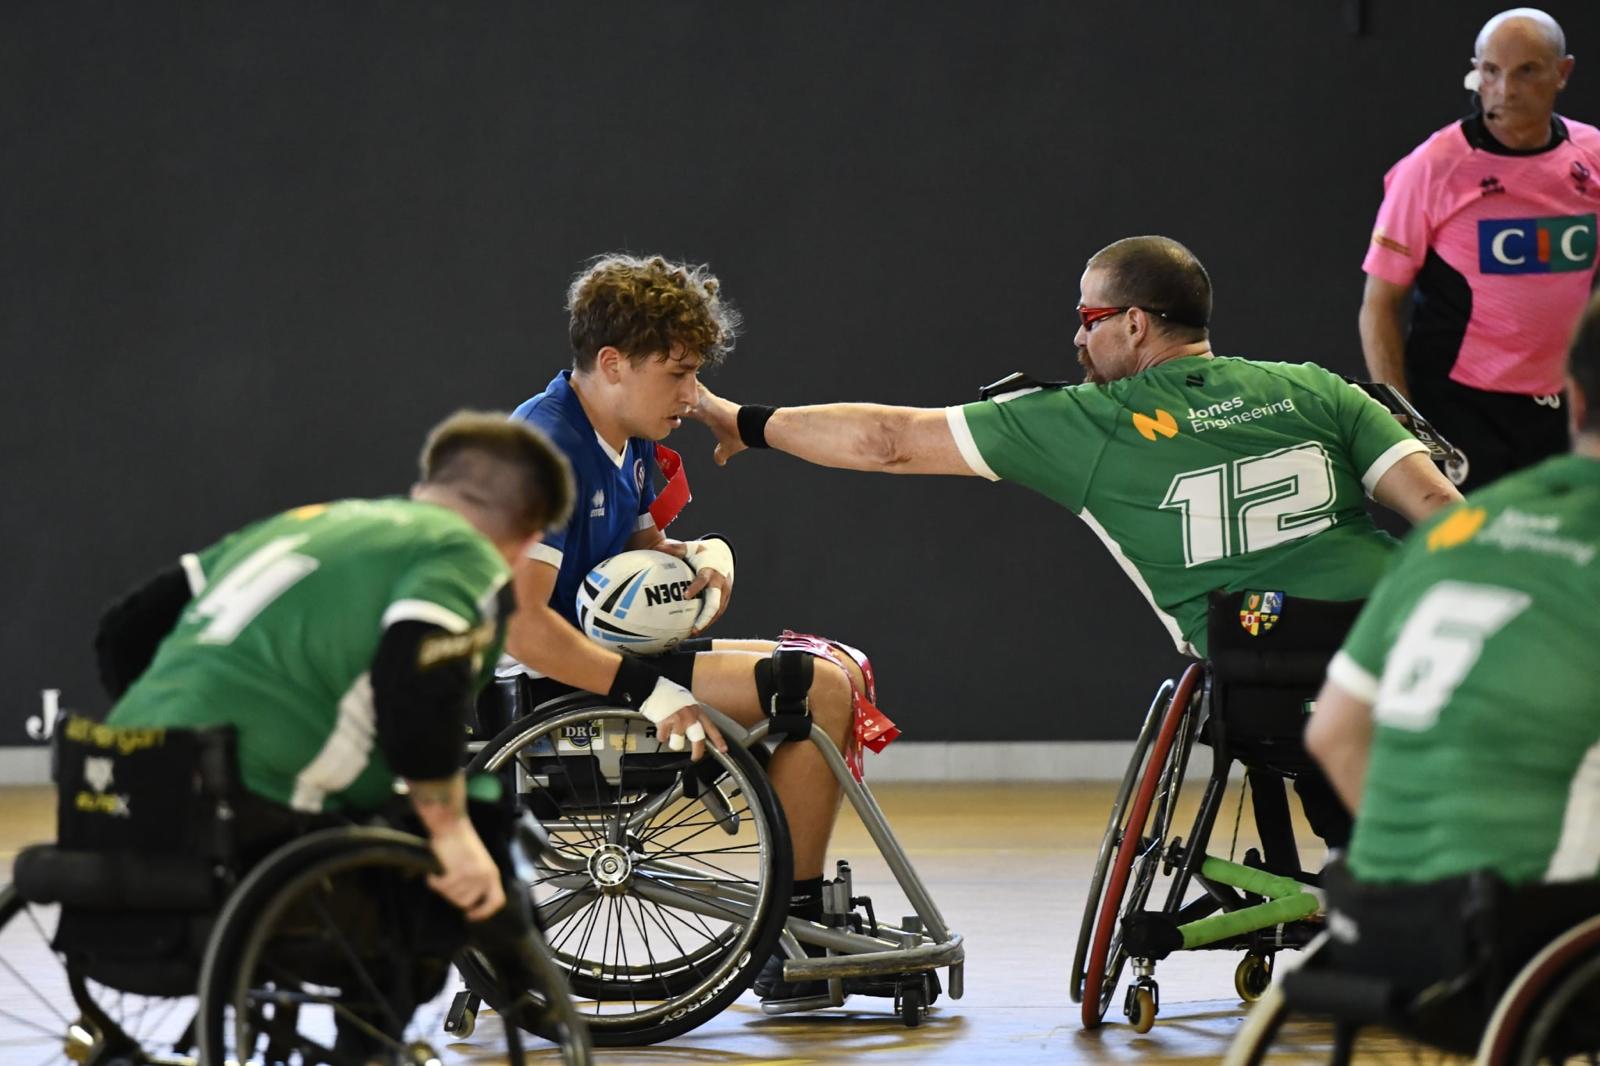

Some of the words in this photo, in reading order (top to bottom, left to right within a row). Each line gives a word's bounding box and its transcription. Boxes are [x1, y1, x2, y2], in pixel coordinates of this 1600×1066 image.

[1491, 224, 1590, 265] CIC
[1187, 397, 1244, 419] Jones
[1190, 398, 1295, 433] Engineering
[1158, 441, 1338, 568] 12
[644, 580, 704, 607] EDEN
[1374, 579, 1532, 733] 6
